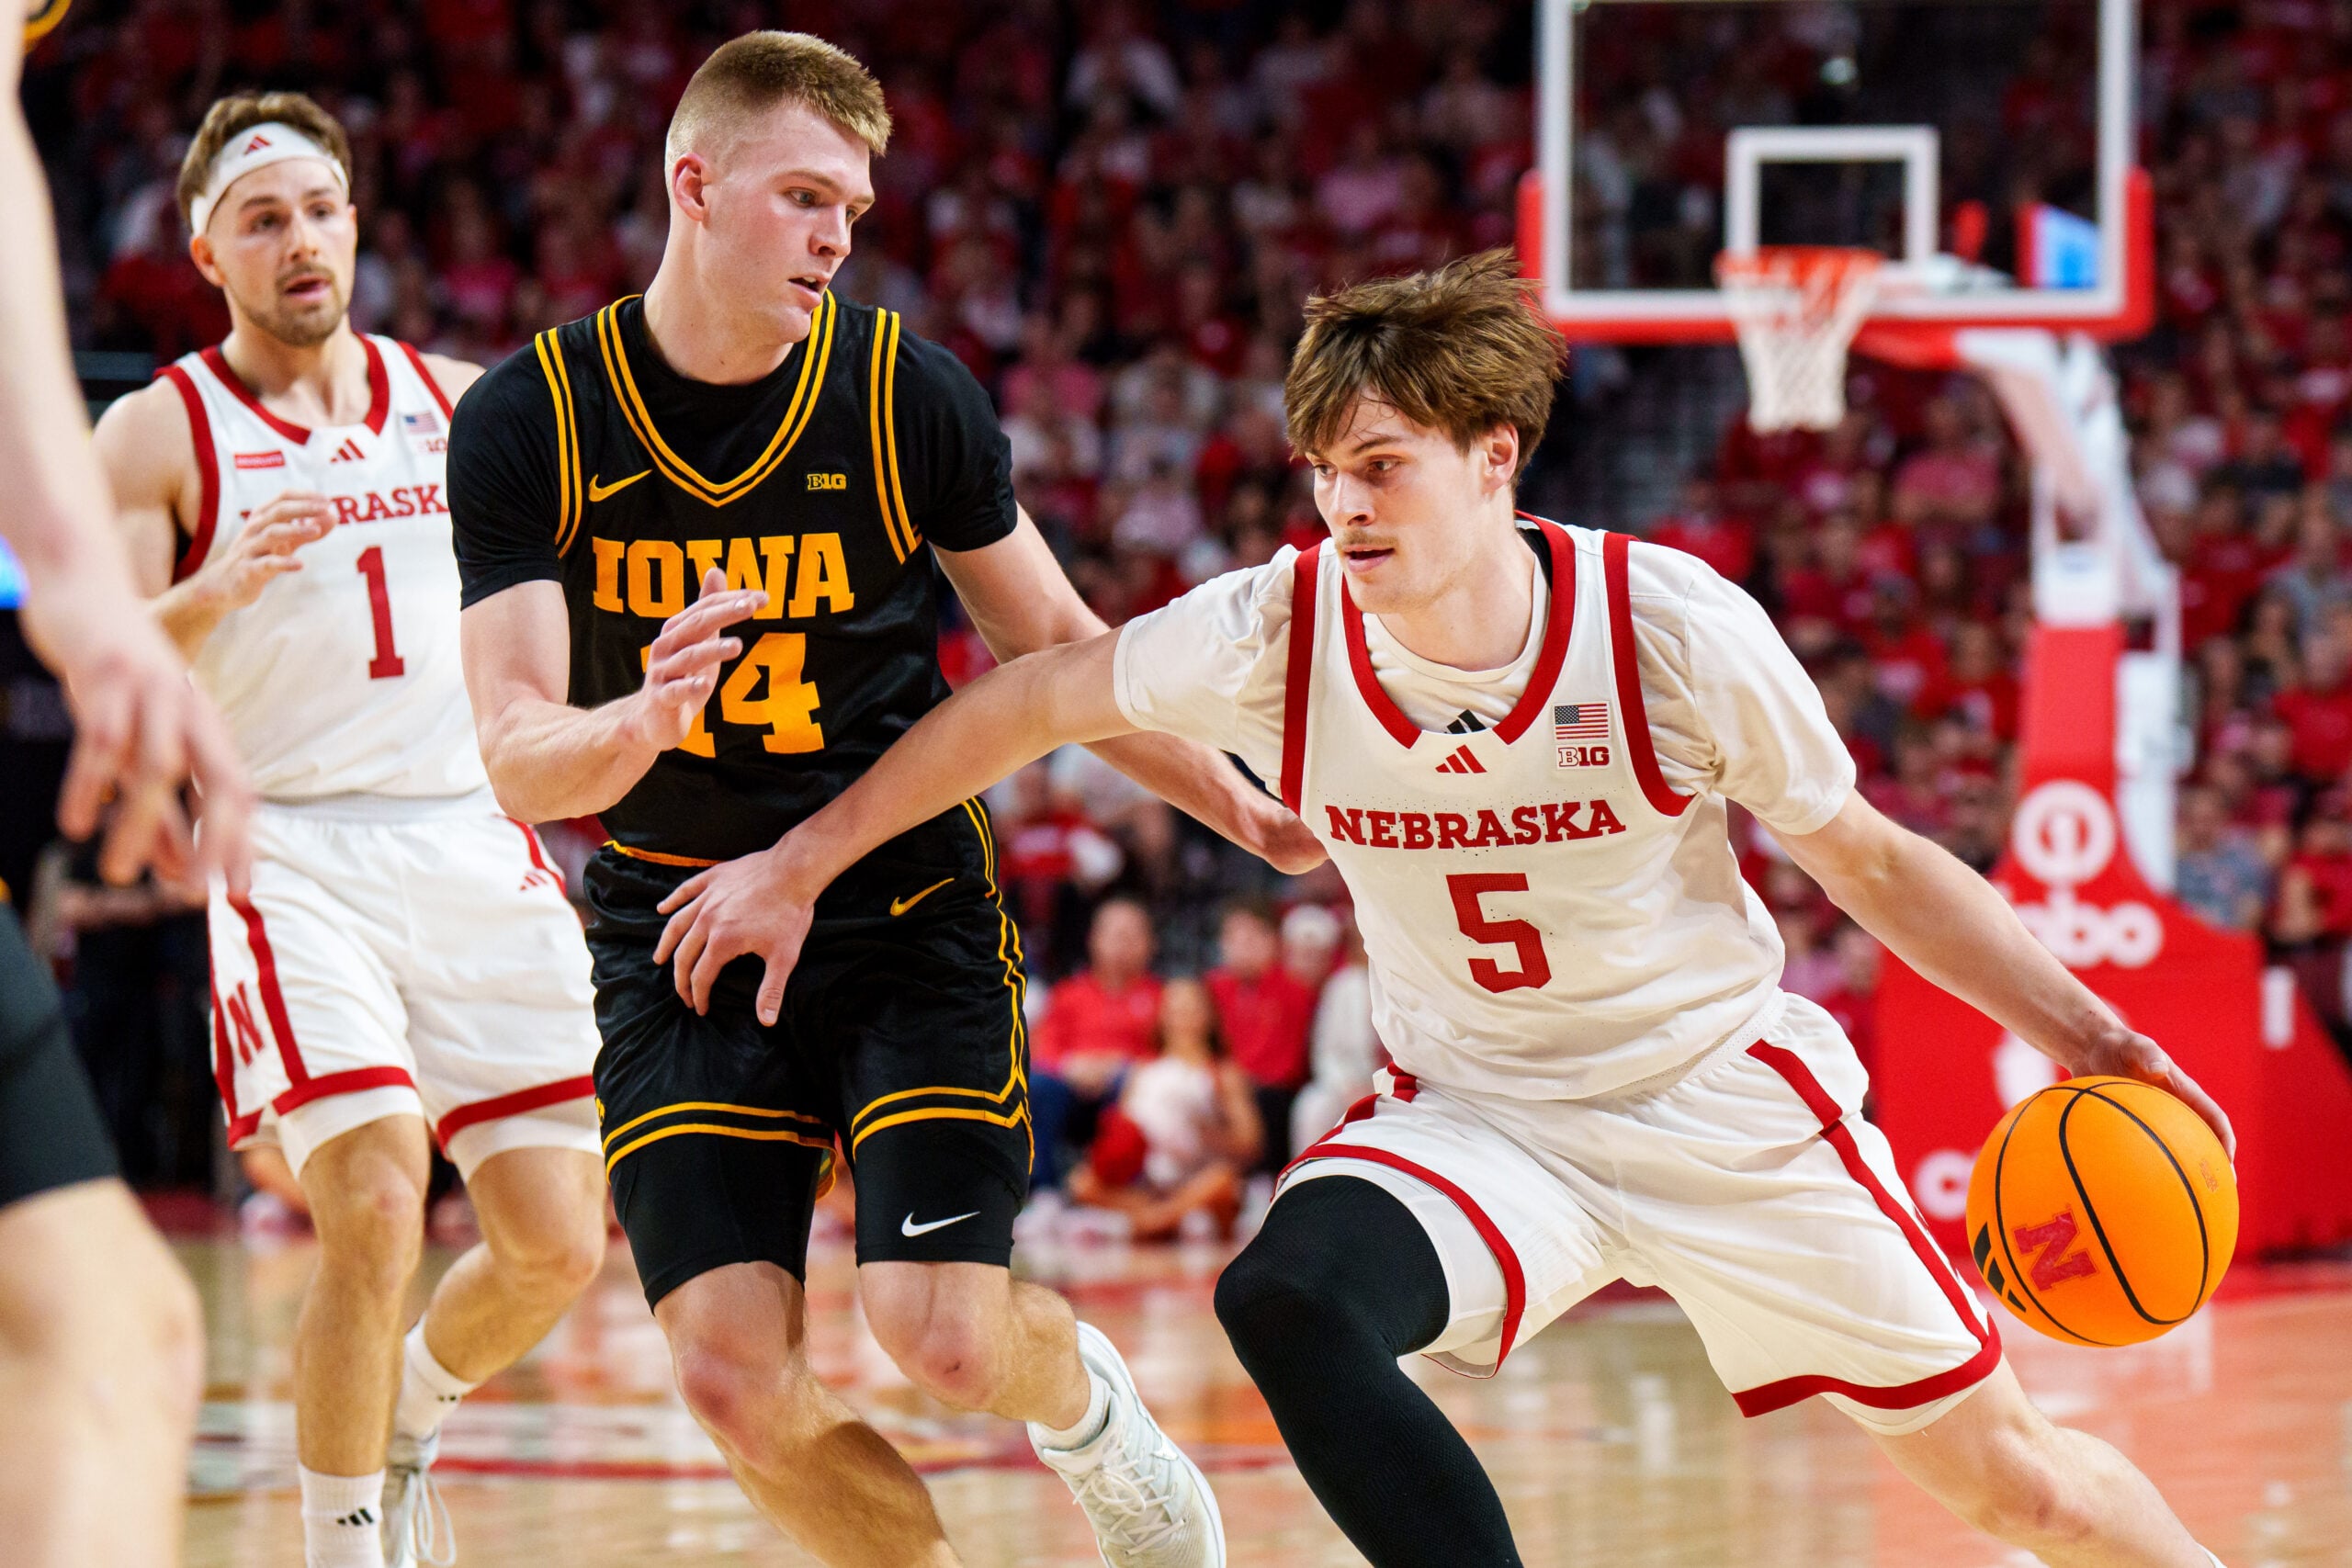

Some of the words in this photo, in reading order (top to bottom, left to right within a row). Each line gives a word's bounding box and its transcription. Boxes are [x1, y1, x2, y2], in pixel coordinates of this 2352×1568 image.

[240, 484, 449, 525] RASK
[356, 546, 405, 679] 1
[592, 532, 854, 620] IOWA
[1324, 798, 1626, 851] NEBRASKA
[1445, 872, 1553, 994] 5
[226, 979, 265, 1067] N
[2013, 1208, 2100, 1293] N
